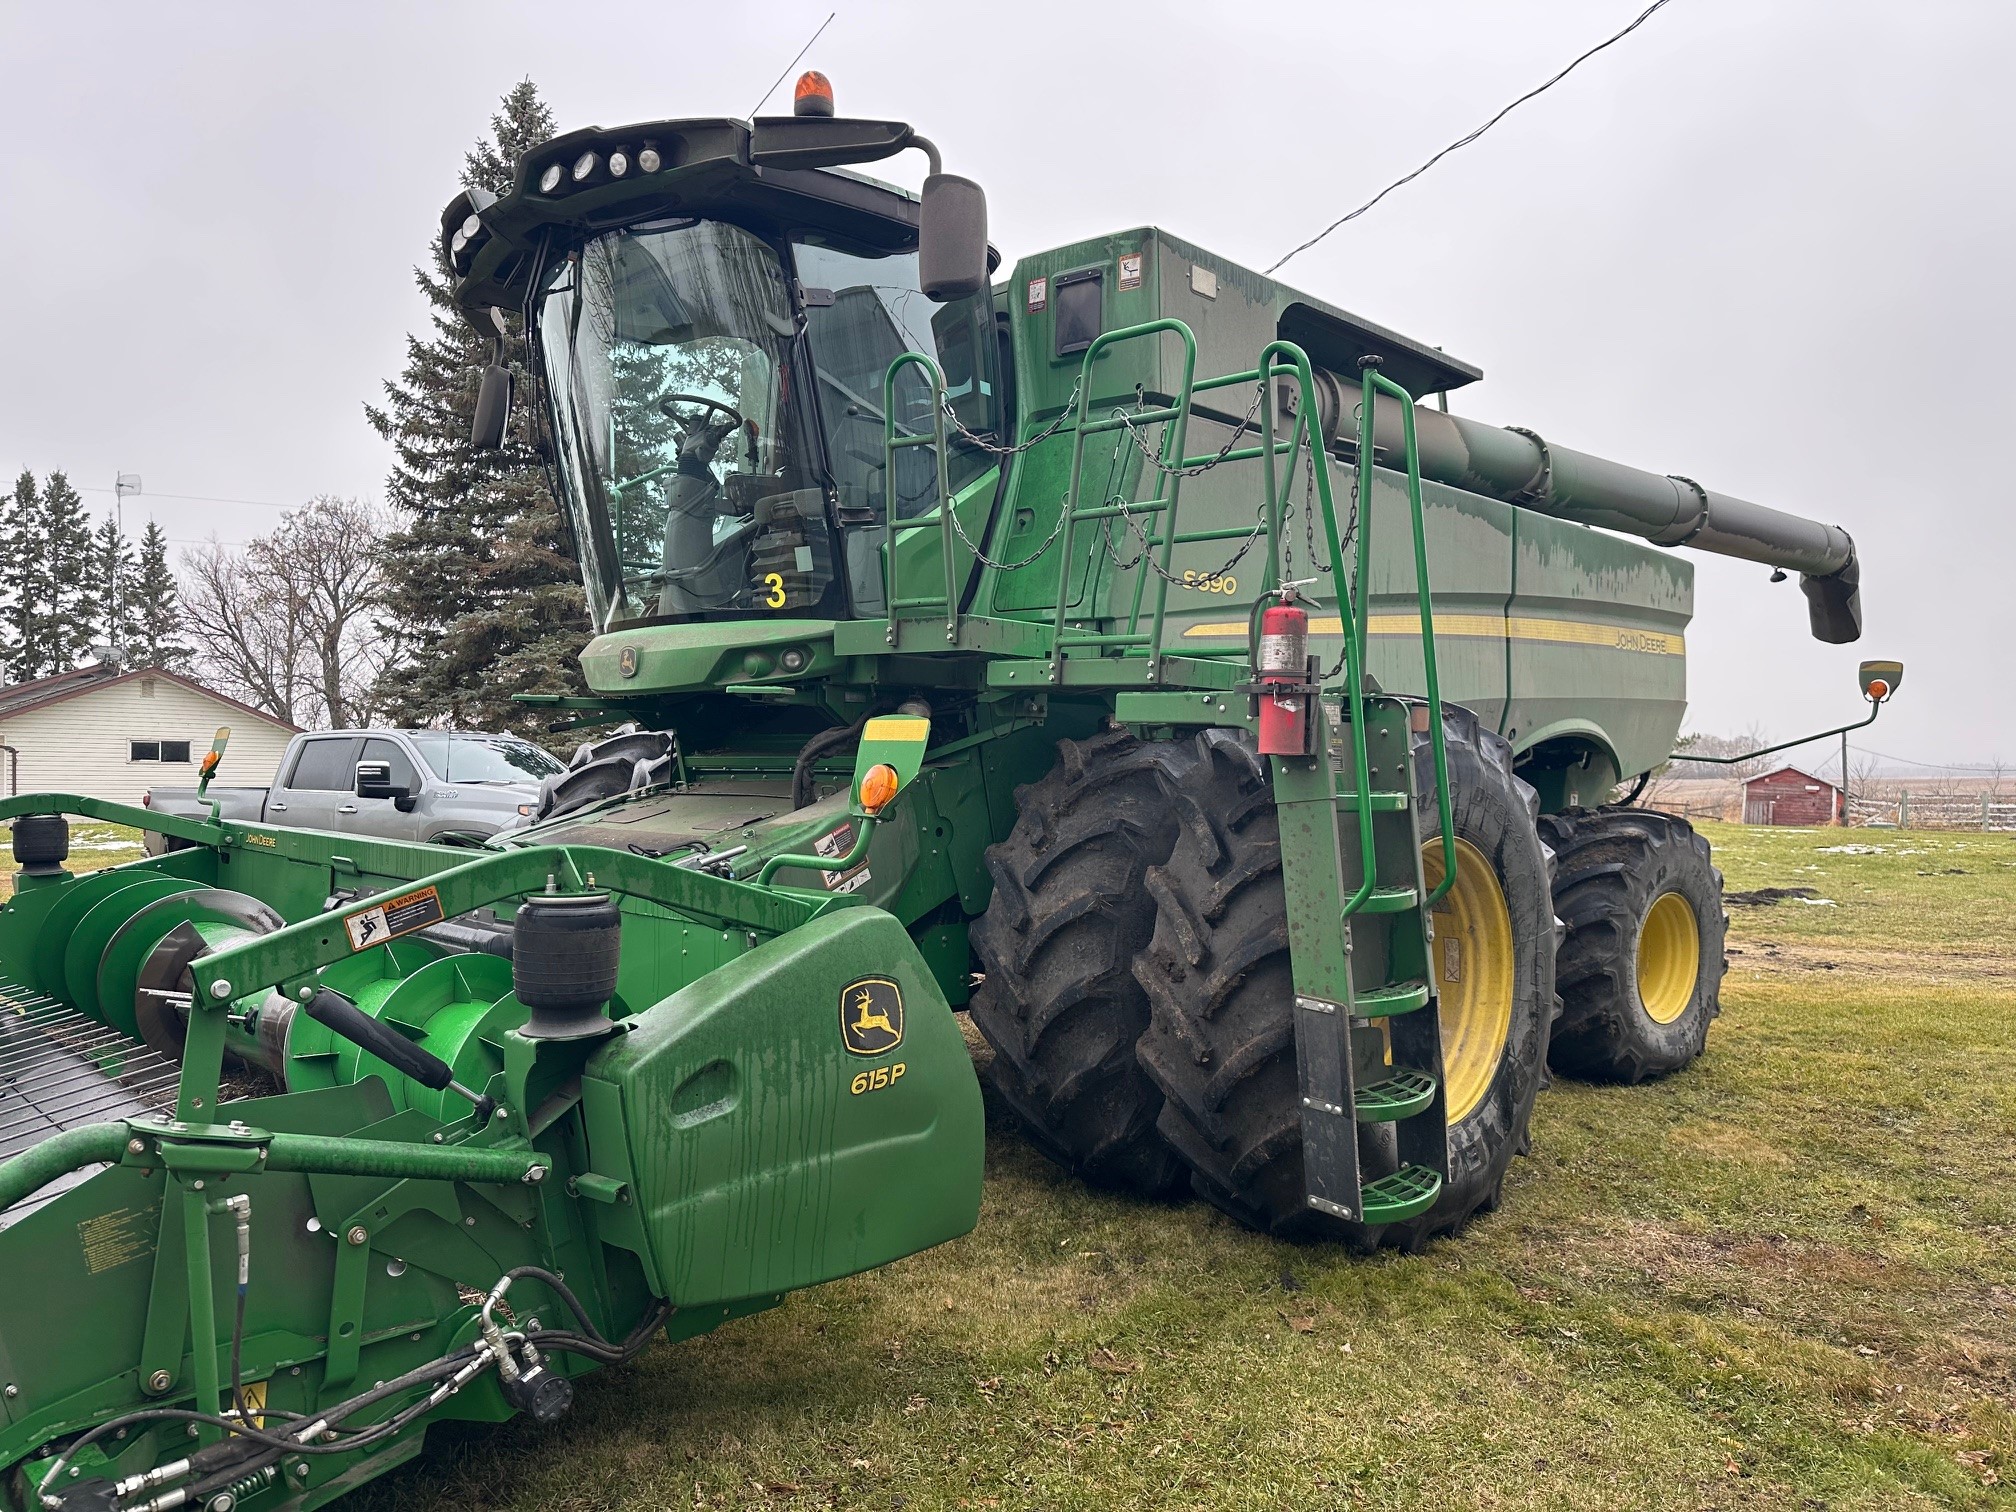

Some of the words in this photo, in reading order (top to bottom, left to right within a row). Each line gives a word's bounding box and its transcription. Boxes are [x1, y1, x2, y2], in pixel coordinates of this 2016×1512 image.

[764, 572, 786, 608] 3
[1183, 569, 1237, 596] S690
[1615, 630, 1639, 649] JOHN
[1640, 633, 1667, 653] DEERE
[245, 832, 259, 845] JOHN
[259, 834, 276, 848] DEERE
[396, 888, 434, 906] WARNING
[850, 1062, 906, 1095] 615P
